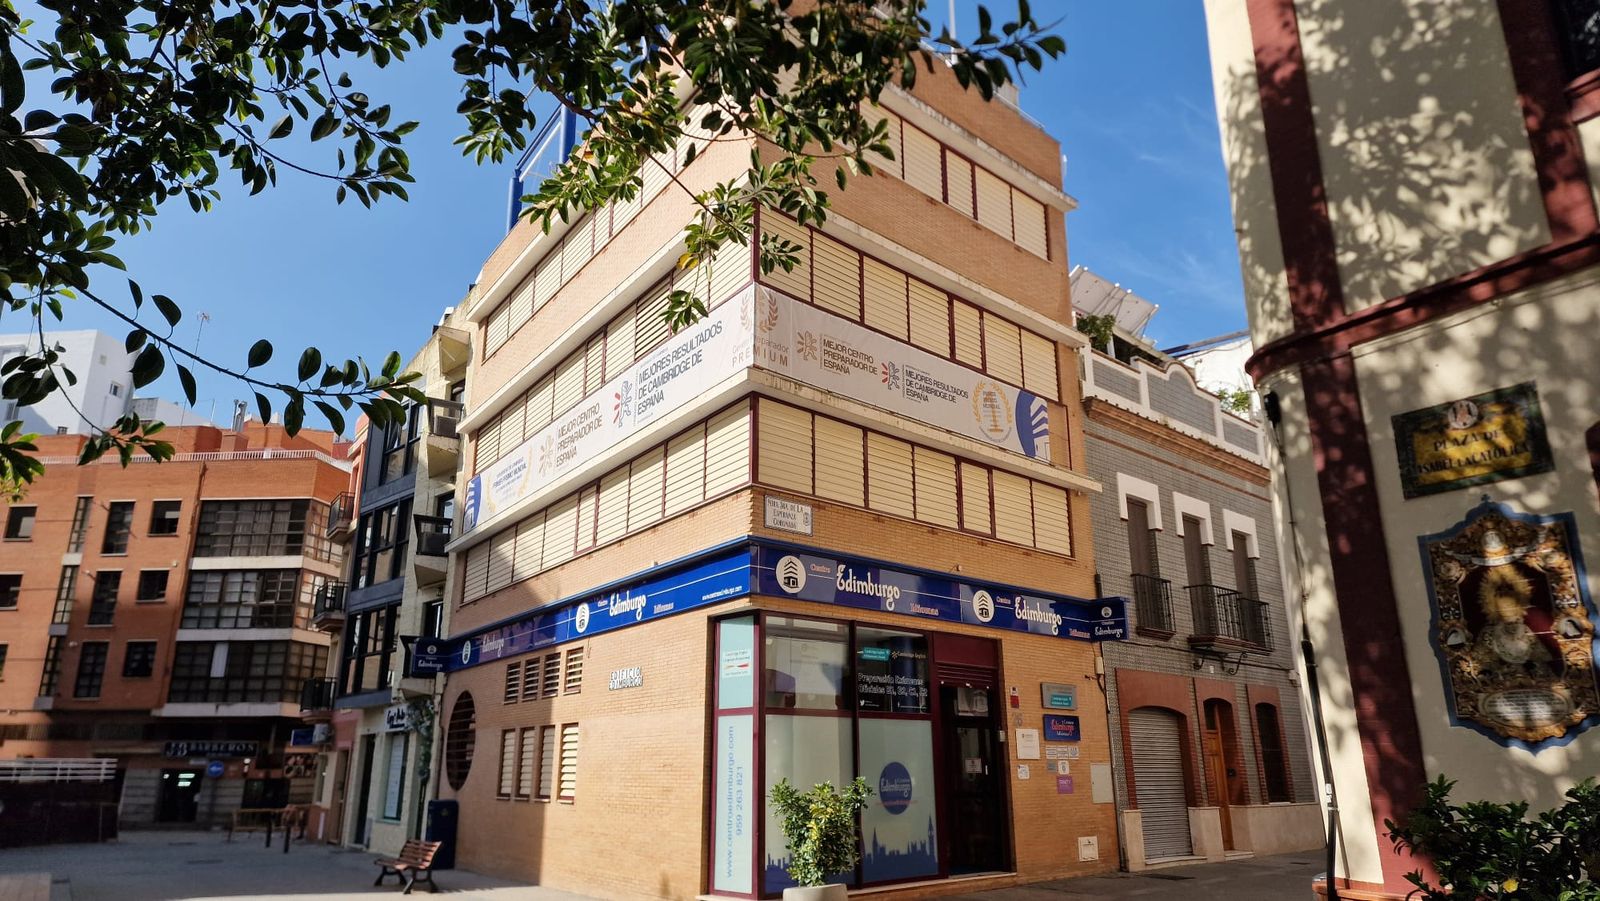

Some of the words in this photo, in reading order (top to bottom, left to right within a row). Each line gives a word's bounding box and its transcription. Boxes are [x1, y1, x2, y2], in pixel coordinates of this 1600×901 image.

[638, 356, 672, 385] MEJORES
[671, 321, 723, 363] RESULTADOS
[823, 339, 847, 354] MEJOR
[847, 346, 874, 364] CENTRO
[823, 349, 869, 373] PREPARADOR
[868, 362, 878, 375] DE
[638, 386, 648, 400] DE
[647, 361, 691, 397] CAMBRIDGE
[691, 349, 703, 367] DE
[823, 358, 850, 375] ESPAÑA
[905, 369, 933, 386] MEJORES
[933, 379, 969, 400] RESULTADOS
[905, 378, 915, 388] DE
[914, 382, 949, 401] CAMBRIDGE
[948, 394, 957, 404] DE
[905, 388, 929, 402] ESPAÑA
[576, 402, 600, 425] CENTRO
[637, 389, 665, 415] ESPAÑA
[557, 420, 594, 451] PREPARADOR
[593, 415, 603, 428] DE
[1433, 432, 1479, 452] PLAZA
[836, 564, 900, 611] Edimburgo
[609, 590, 647, 621] Edimburgo
[1015, 596, 1062, 636] Edimburgo
[736, 766, 744, 786] 821
[726, 726, 735, 879] www.centroedimburgo.com
[736, 788, 744, 811] 263
[736, 814, 744, 836] 959
